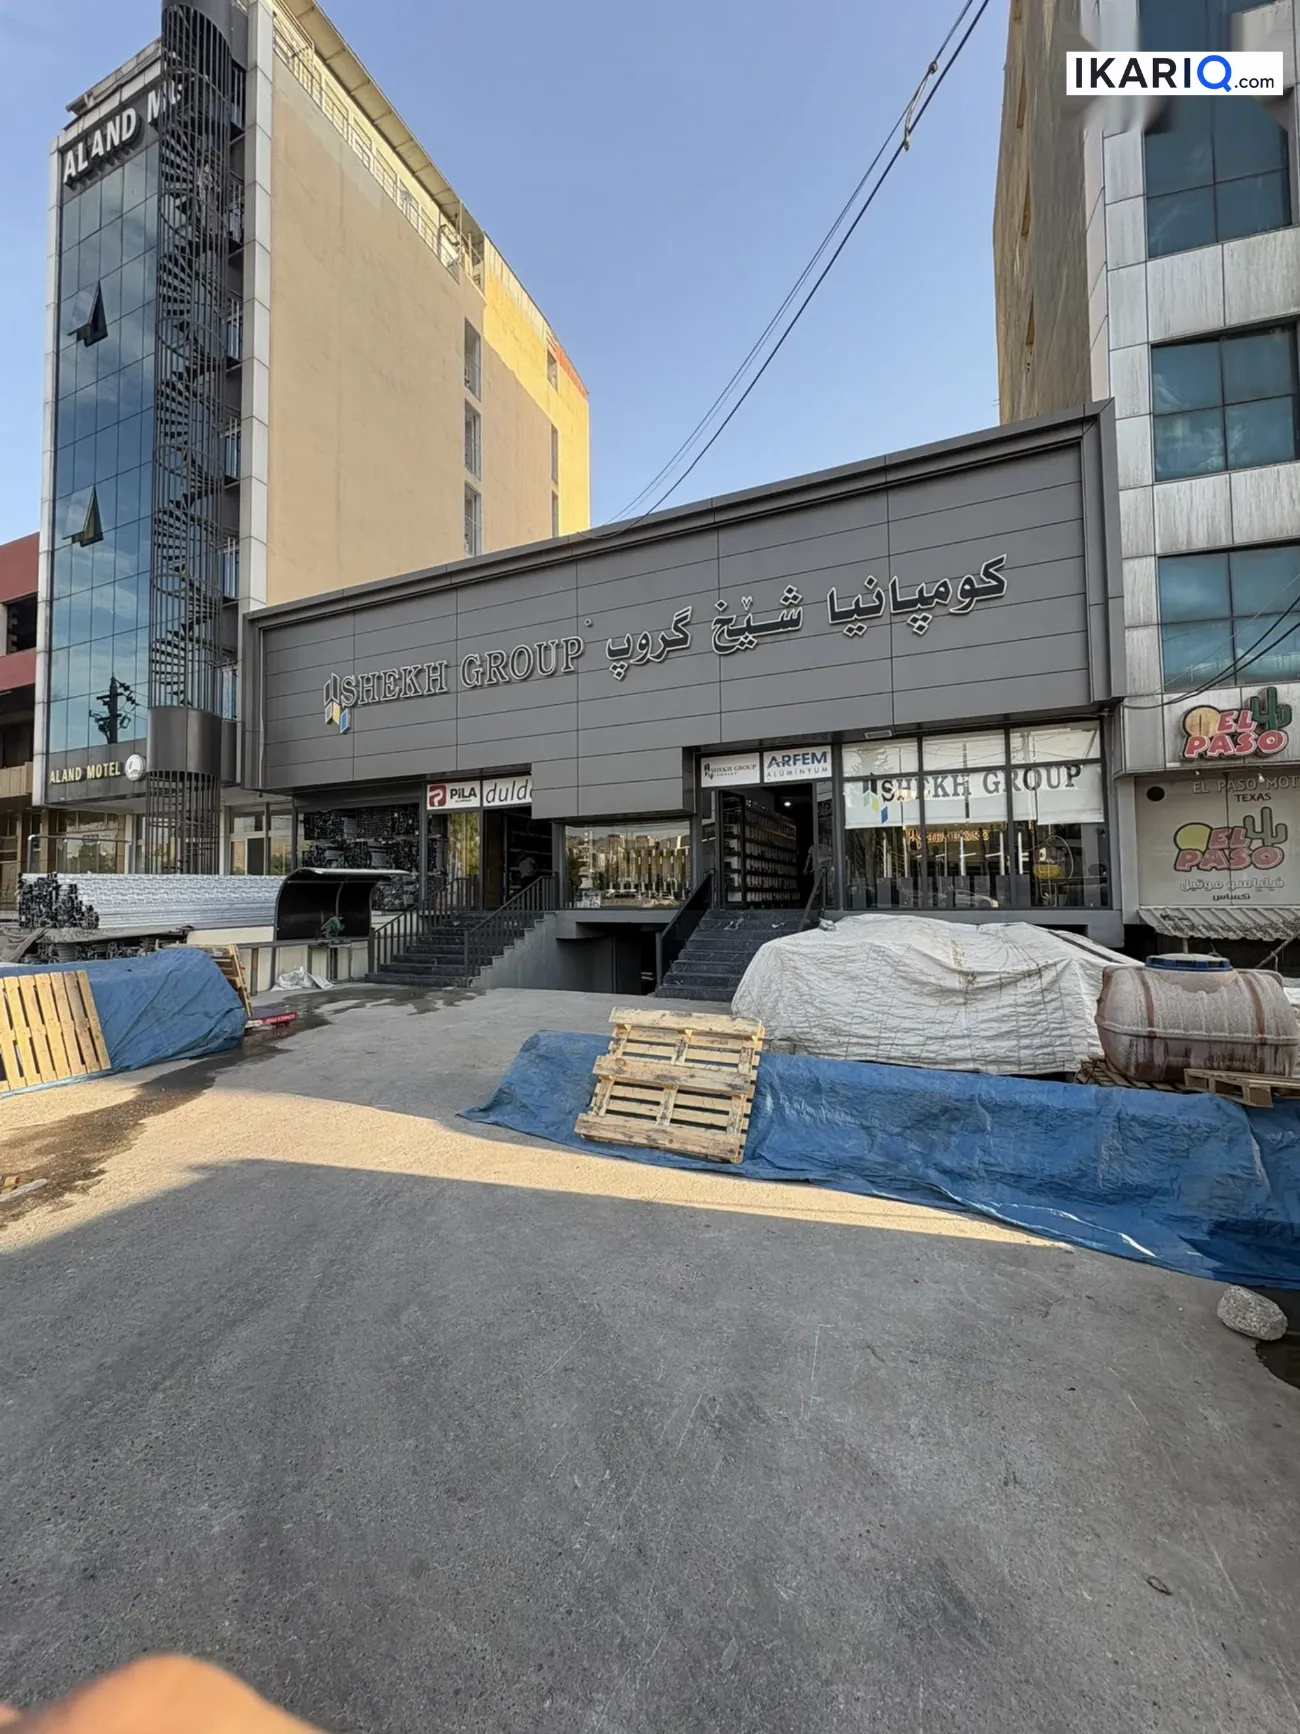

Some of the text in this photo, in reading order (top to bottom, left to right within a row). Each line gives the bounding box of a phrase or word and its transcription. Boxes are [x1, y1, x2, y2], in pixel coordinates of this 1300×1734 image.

[63, 107, 137, 183] ALAND
[827, 553, 1008, 636] کومپانیا
[605, 605, 693, 681] گروپ
[340, 636, 584, 707] SHEKH GROUP
[1216, 709, 1257, 733] EL
[1184, 729, 1289, 758] PASO
[50, 761, 121, 784] ALAND MOTEL
[766, 751, 828, 769] ARFEM
[486, 779, 532, 804] duld
[982, 764, 1082, 794] GROUP
[1193, 775, 1300, 794] EL PASO MOT
[1235, 793, 1271, 802] TEXAS
[1207, 826, 1252, 849] EL
[1174, 846, 1284, 872] PASO
